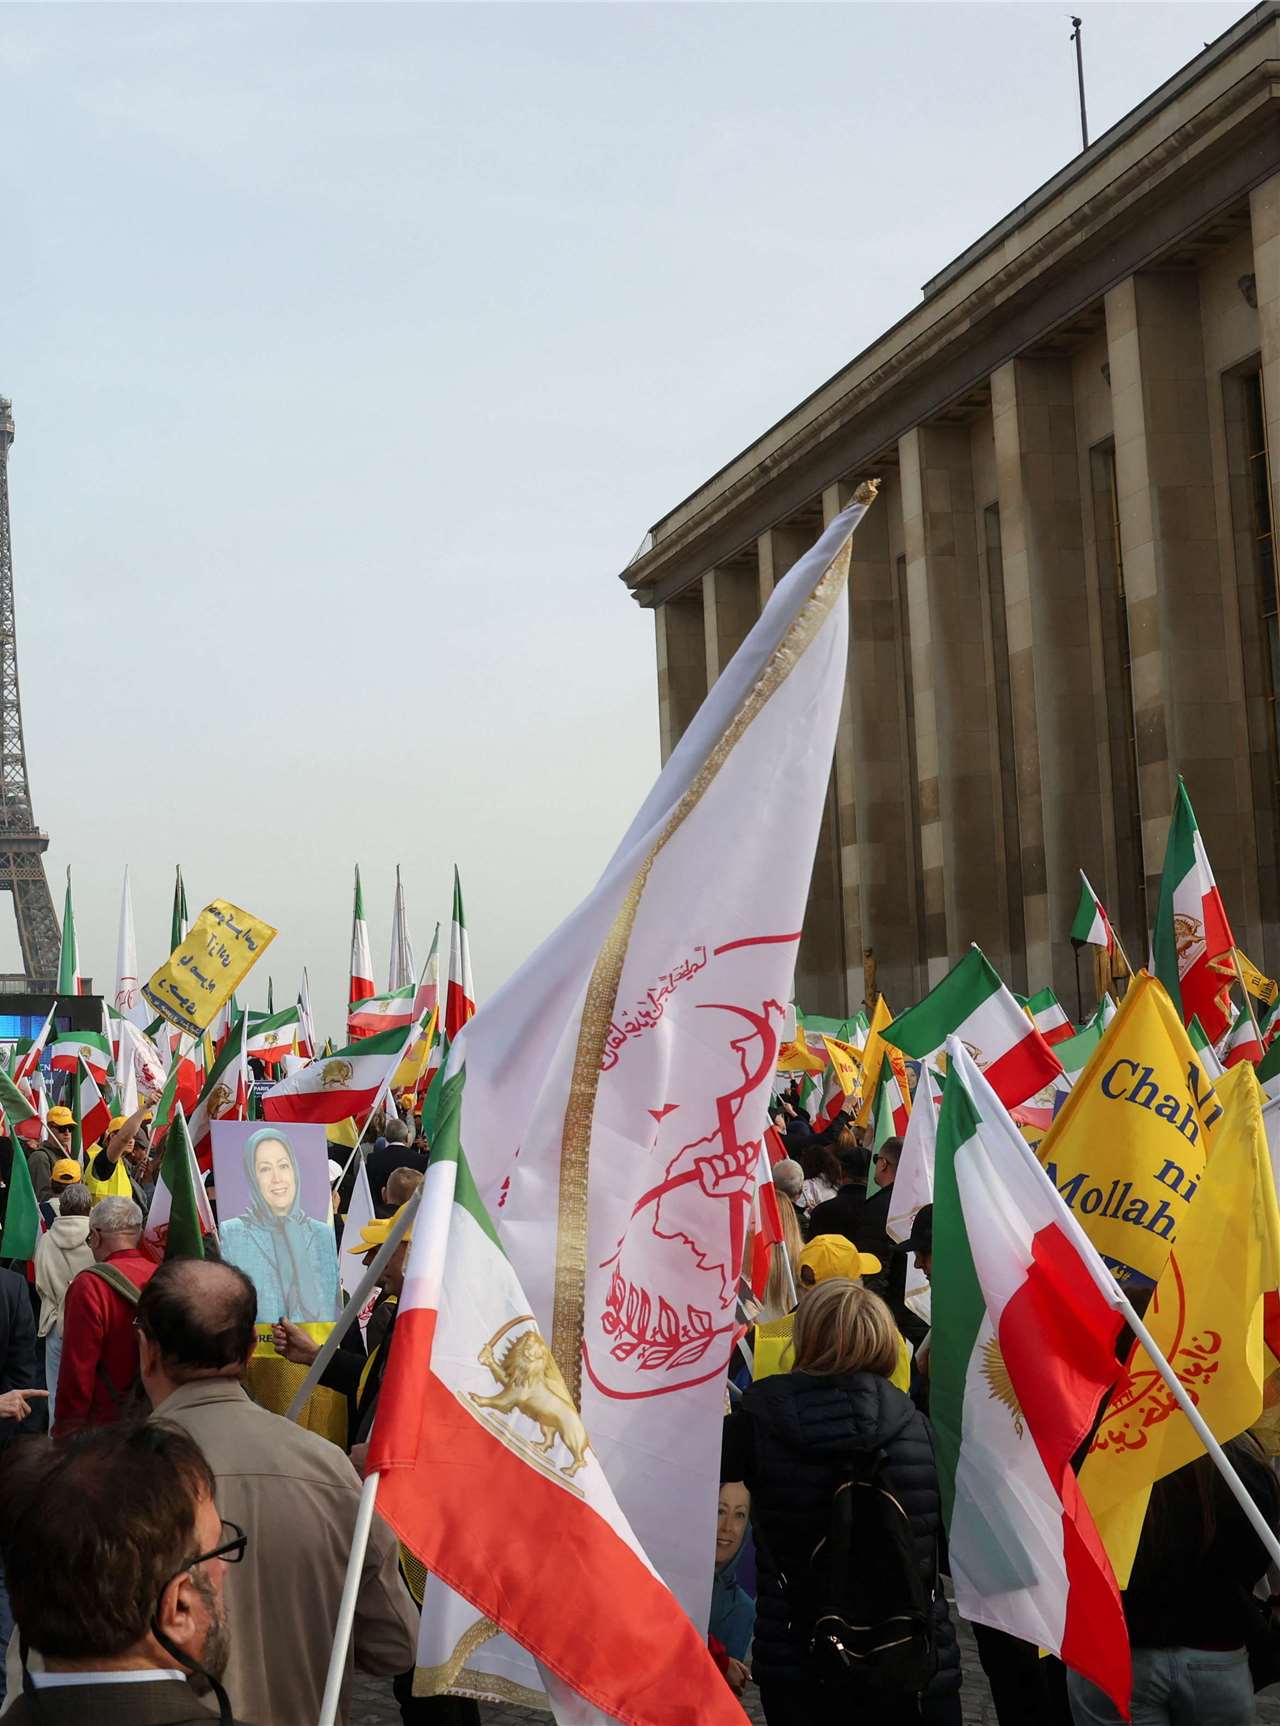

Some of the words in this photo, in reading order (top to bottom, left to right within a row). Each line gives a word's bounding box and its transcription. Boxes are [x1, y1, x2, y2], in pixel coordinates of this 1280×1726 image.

[1101, 1058, 1199, 1148] Chah
[1044, 1162, 1177, 1244] Mollah
[1153, 1158, 1201, 1204] ni
